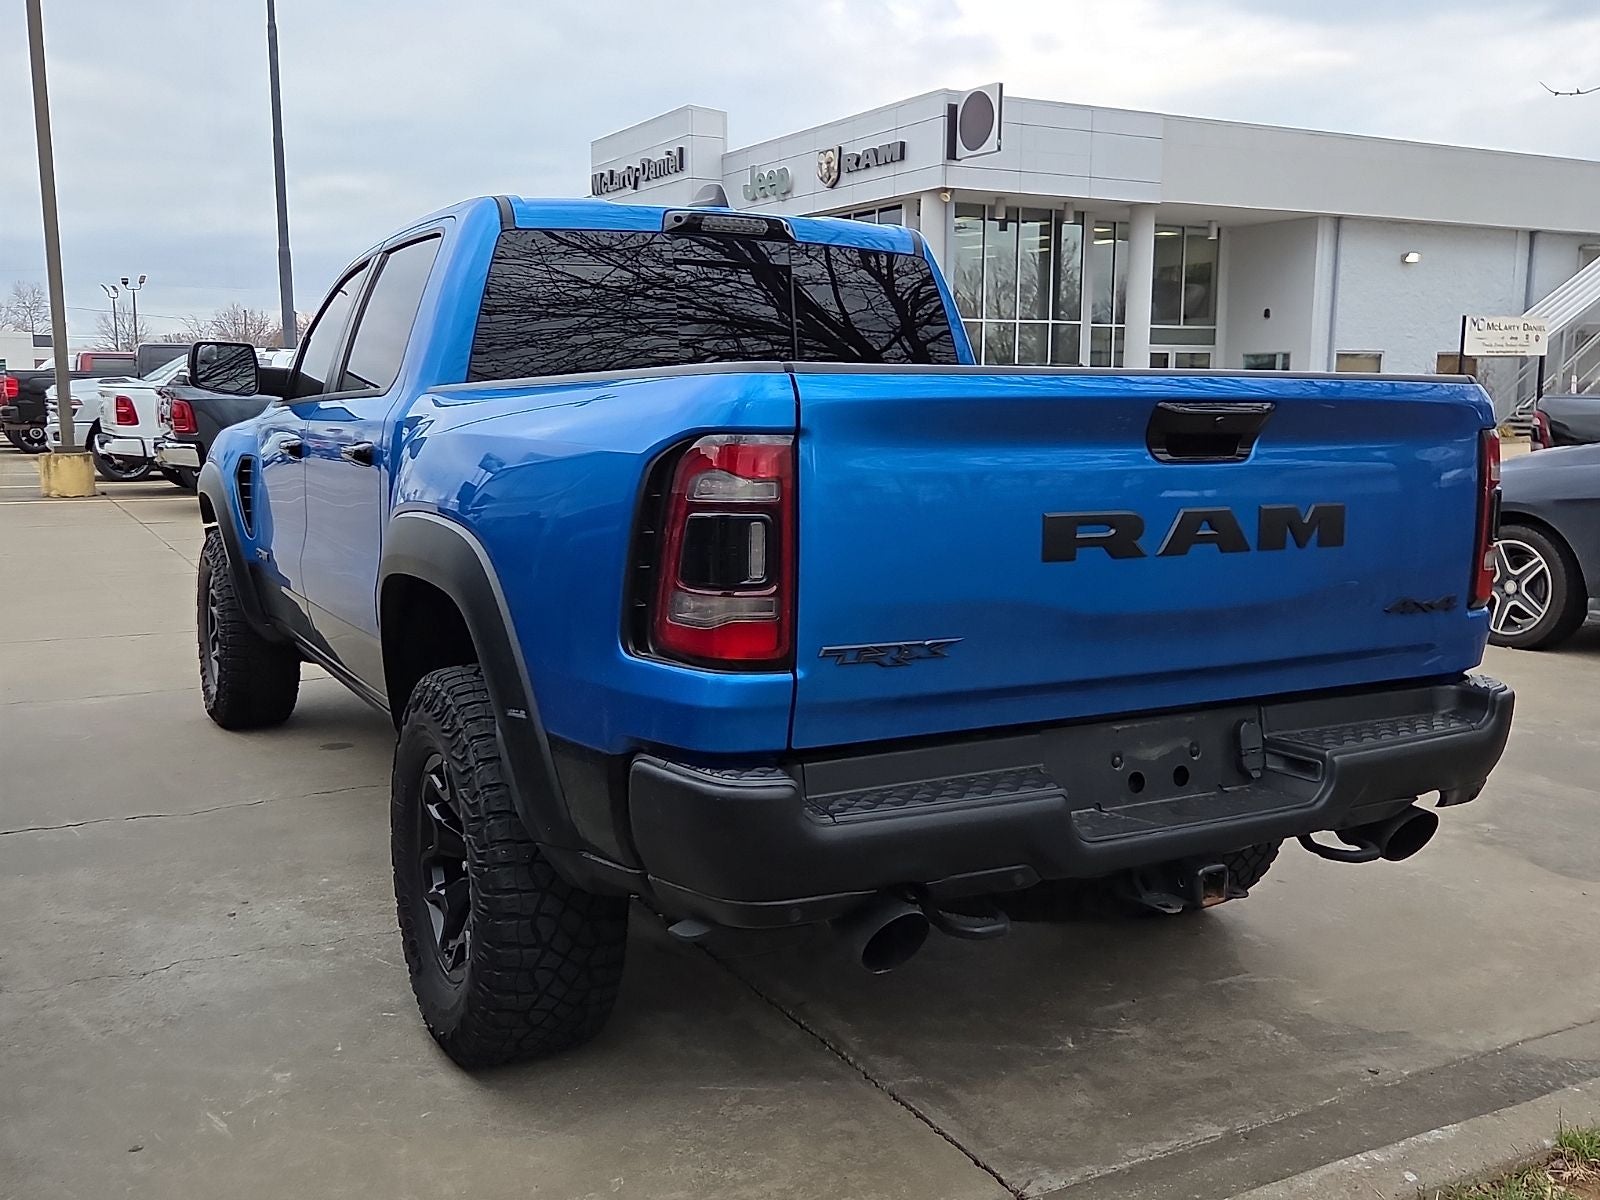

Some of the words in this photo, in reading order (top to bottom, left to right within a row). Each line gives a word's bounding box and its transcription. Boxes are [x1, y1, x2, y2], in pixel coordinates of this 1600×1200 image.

[842, 141, 906, 173] RAM
[743, 165, 793, 201] Jeep
[1042, 503, 1345, 562] RAM
